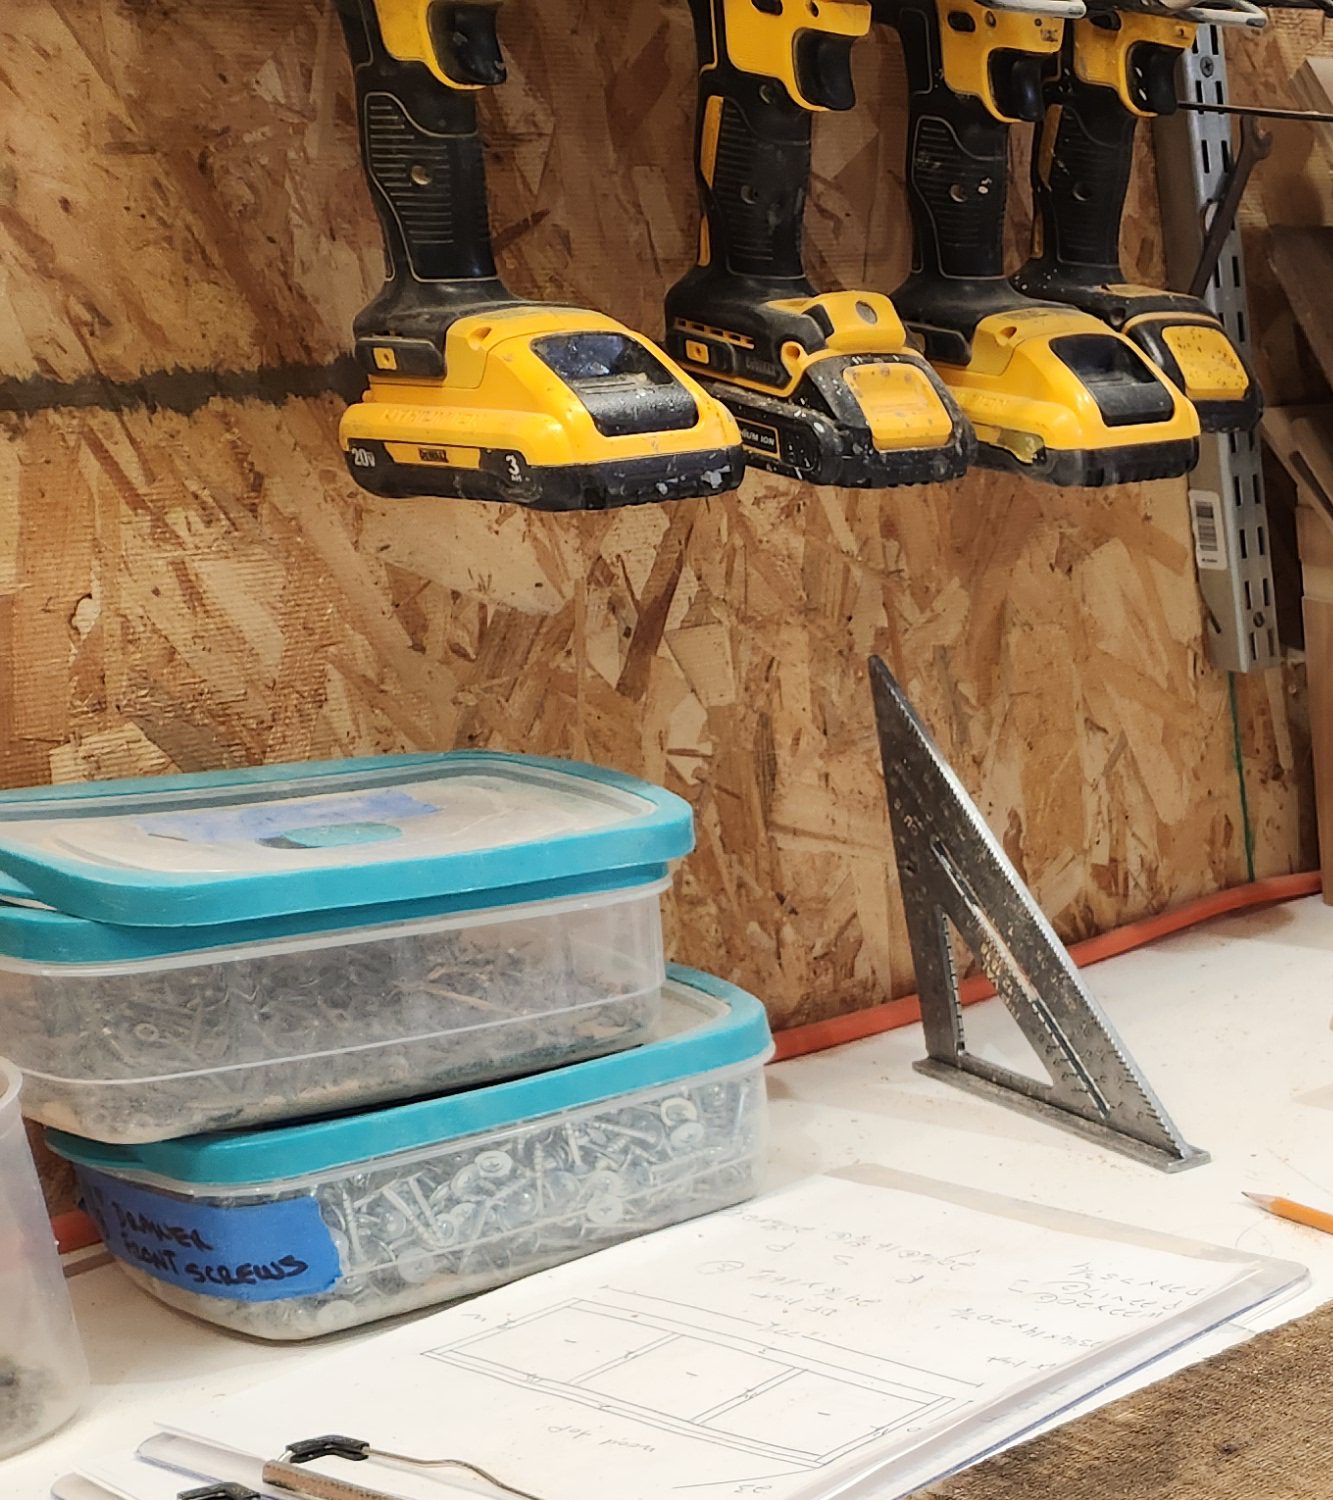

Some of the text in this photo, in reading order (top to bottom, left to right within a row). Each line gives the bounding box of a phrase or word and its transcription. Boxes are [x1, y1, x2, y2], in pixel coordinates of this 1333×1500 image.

[760, 435, 775, 446] ION
[505, 454, 520, 476] 3
[111, 1200, 214, 1252] DRAWER
[184, 1253, 309, 1287] SCREWS
